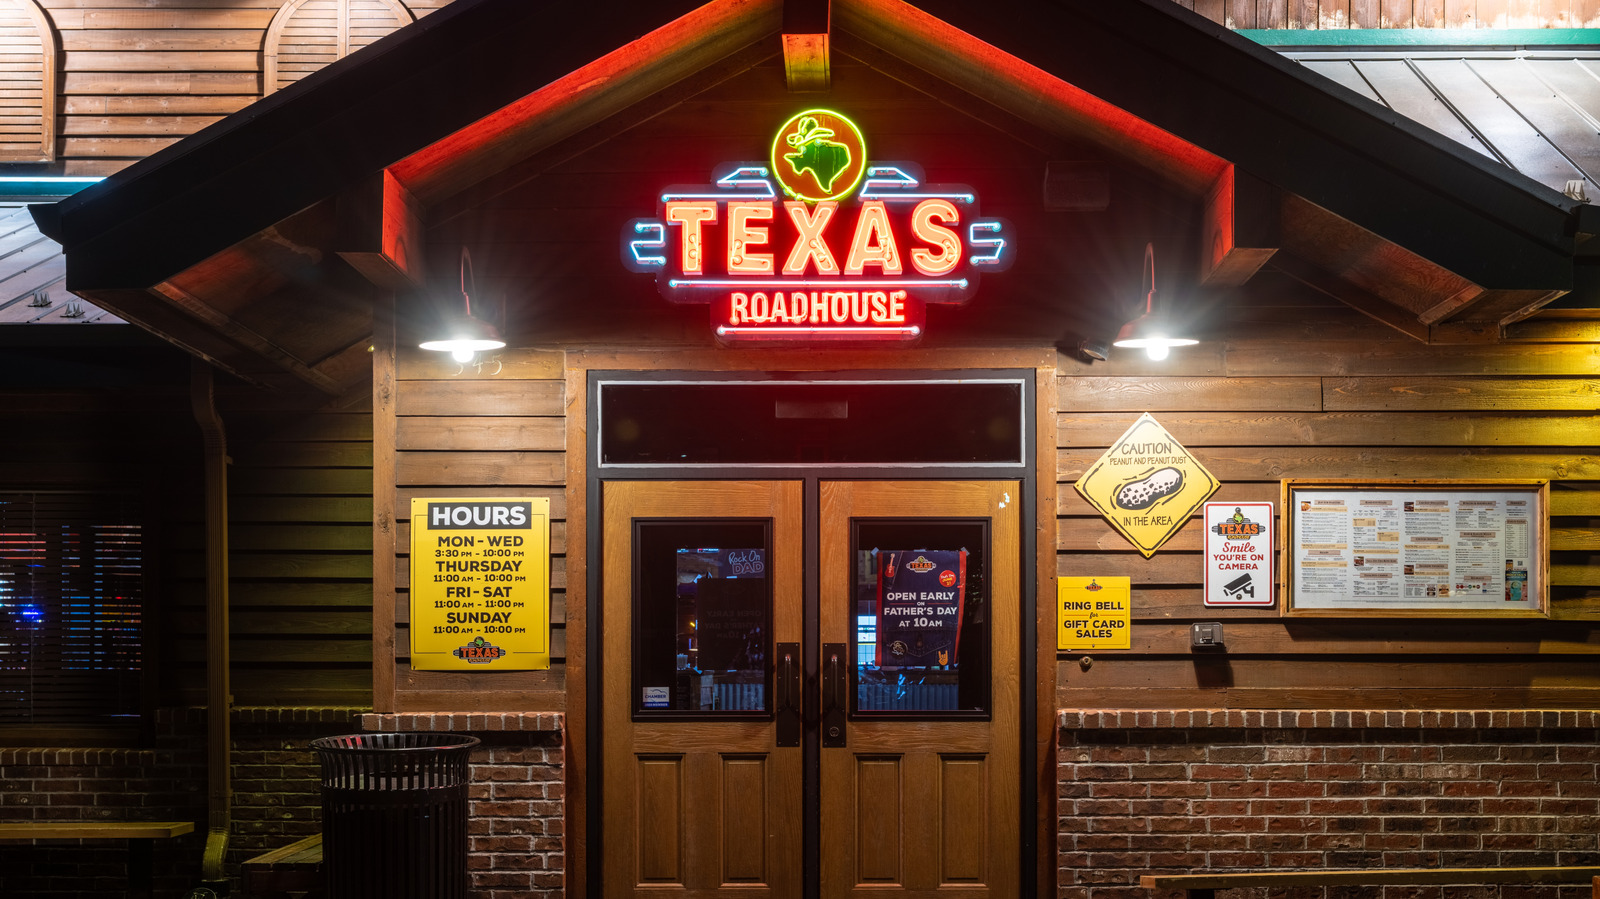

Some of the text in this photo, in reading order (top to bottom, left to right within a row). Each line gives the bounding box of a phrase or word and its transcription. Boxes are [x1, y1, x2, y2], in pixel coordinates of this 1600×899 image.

[665, 199, 963, 277] TEXAS
[730, 291, 907, 324] ROADHOUSE
[1121, 442, 1172, 455] CAUTION
[1109, 456, 1187, 466] PEANUT AND PEANUT DUST
[432, 506, 527, 526] HOURS
[1123, 516, 1173, 526] IN THE AREA
[1219, 524, 1258, 534] TEXAS
[437, 536, 475, 547] MON
[487, 536, 524, 547] WED
[1222, 542, 1256, 553] Smile
[435, 549, 459, 557] 3:30
[483, 549, 511, 557] 10:00
[728, 550, 760, 564] Rock On
[435, 560, 523, 572] THURSDAY
[732, 561, 764, 575] DAD
[433, 574, 460, 582] 11:00
[484, 574, 512, 582] 10:00
[446, 586, 471, 598] FRI
[483, 586, 513, 598] SAT
[886, 592, 955, 601] OPEN EARLY
[434, 600, 461, 608] 11:00
[485, 600, 511, 608] 11:00
[1063, 601, 1125, 610] RING BELL
[884, 607, 957, 616] FATHER'S DAY
[1089, 611, 1099, 619] for
[446, 611, 513, 624] SUNDAY
[1063, 620, 1125, 628] GIFT CARD
[433, 625, 460, 634] 11:00
[483, 625, 512, 634] 10:00
[1076, 630, 1113, 638] SALES
[461, 647, 499, 658] TEXAS
